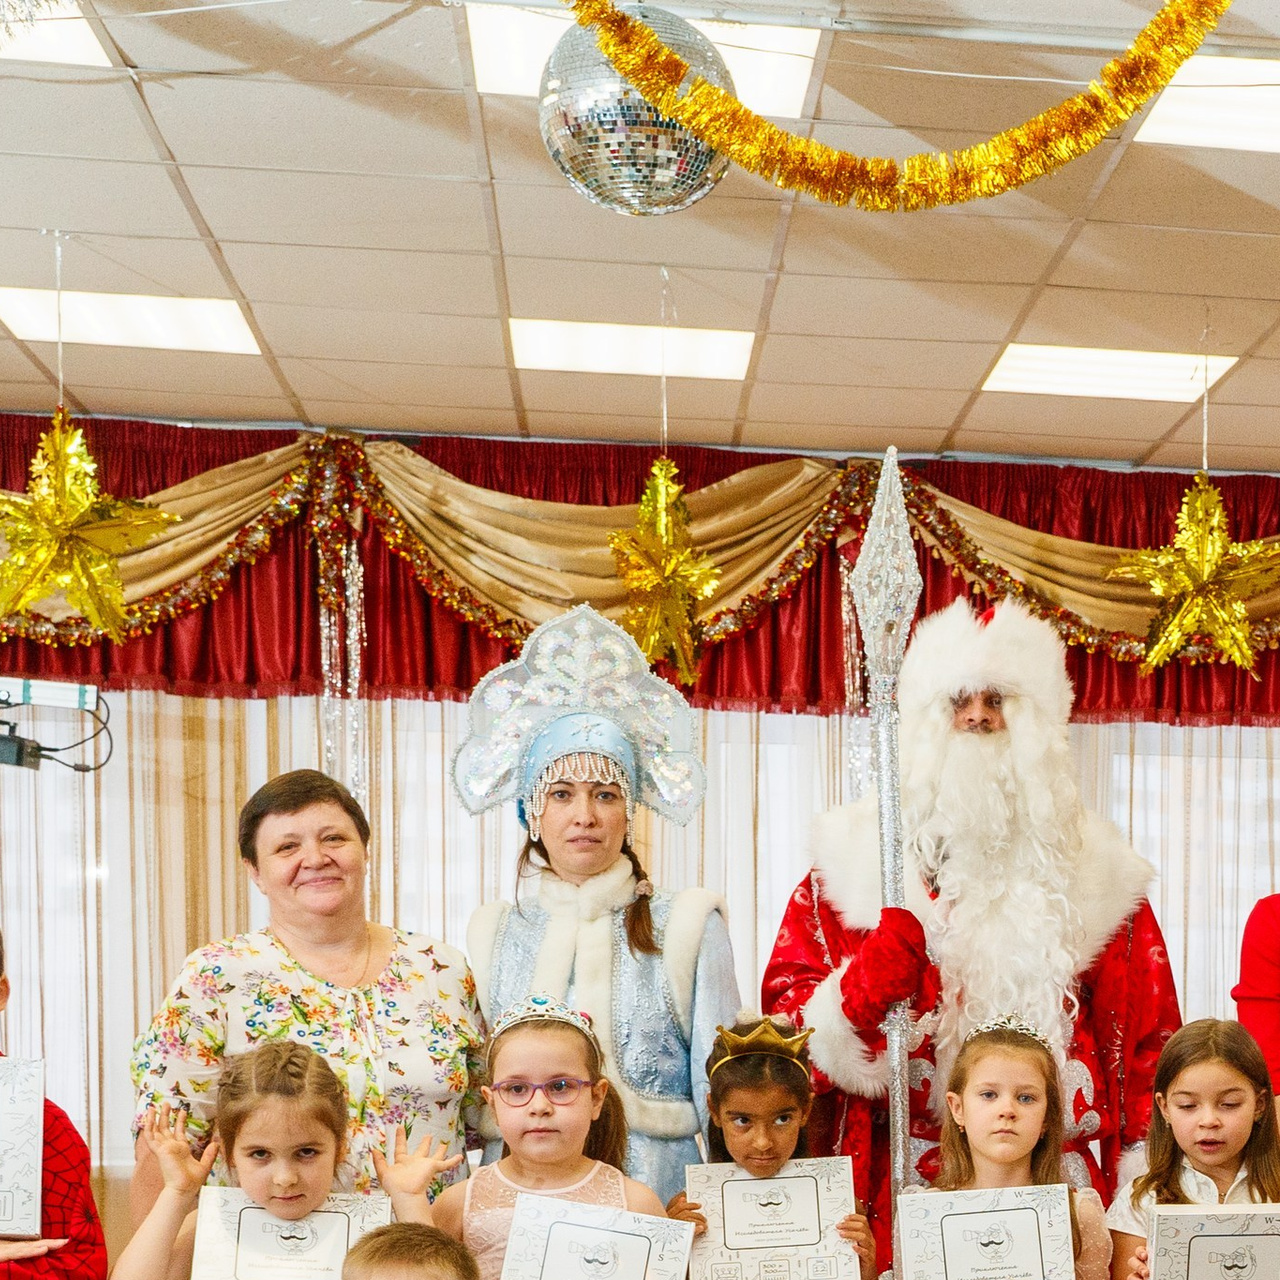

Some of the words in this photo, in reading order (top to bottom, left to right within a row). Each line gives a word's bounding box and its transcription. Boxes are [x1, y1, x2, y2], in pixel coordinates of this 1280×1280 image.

[9, 1096, 16, 1104] S
[633, 1216, 643, 1224] W
[1048, 1220, 1053, 1228] S
[658, 1253, 665, 1262] S
